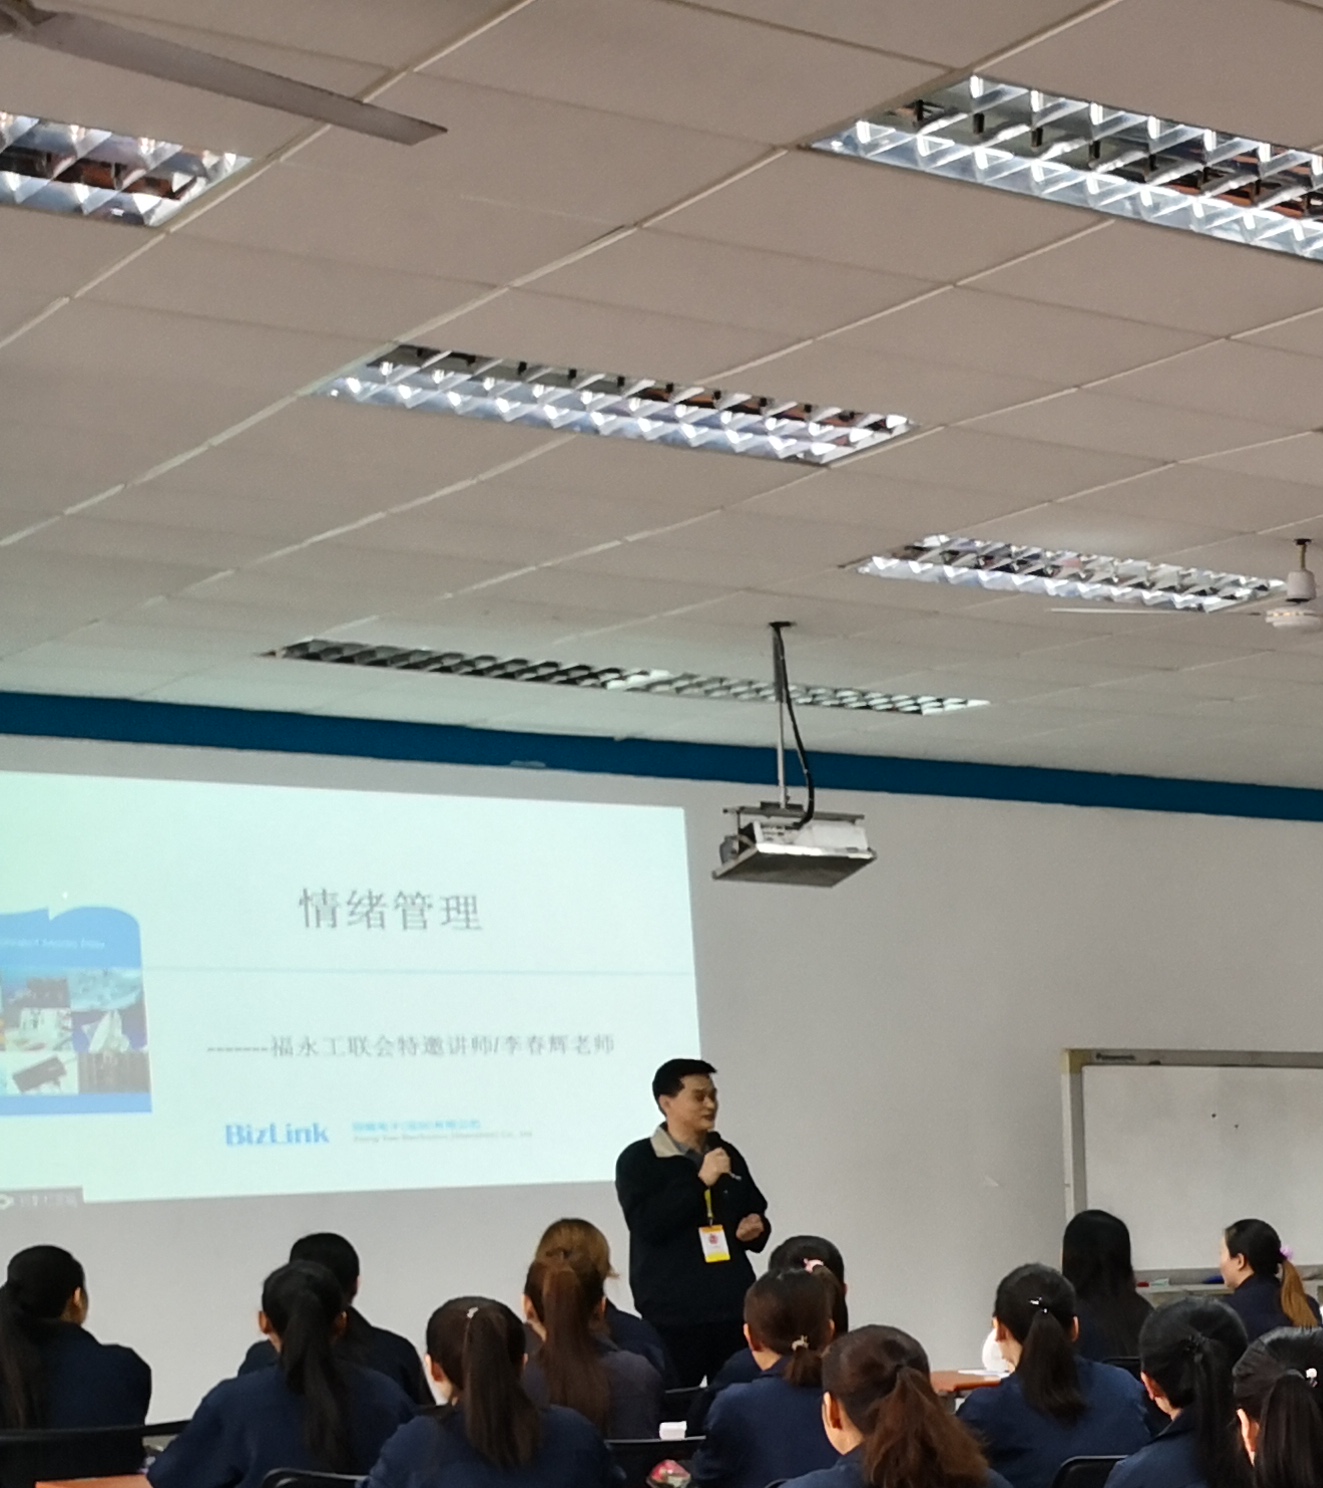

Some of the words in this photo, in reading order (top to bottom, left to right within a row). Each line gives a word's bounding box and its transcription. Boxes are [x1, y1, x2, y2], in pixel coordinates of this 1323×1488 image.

[299, 887, 482, 931] 情绪管理
[225, 1121, 330, 1146] BizLink
